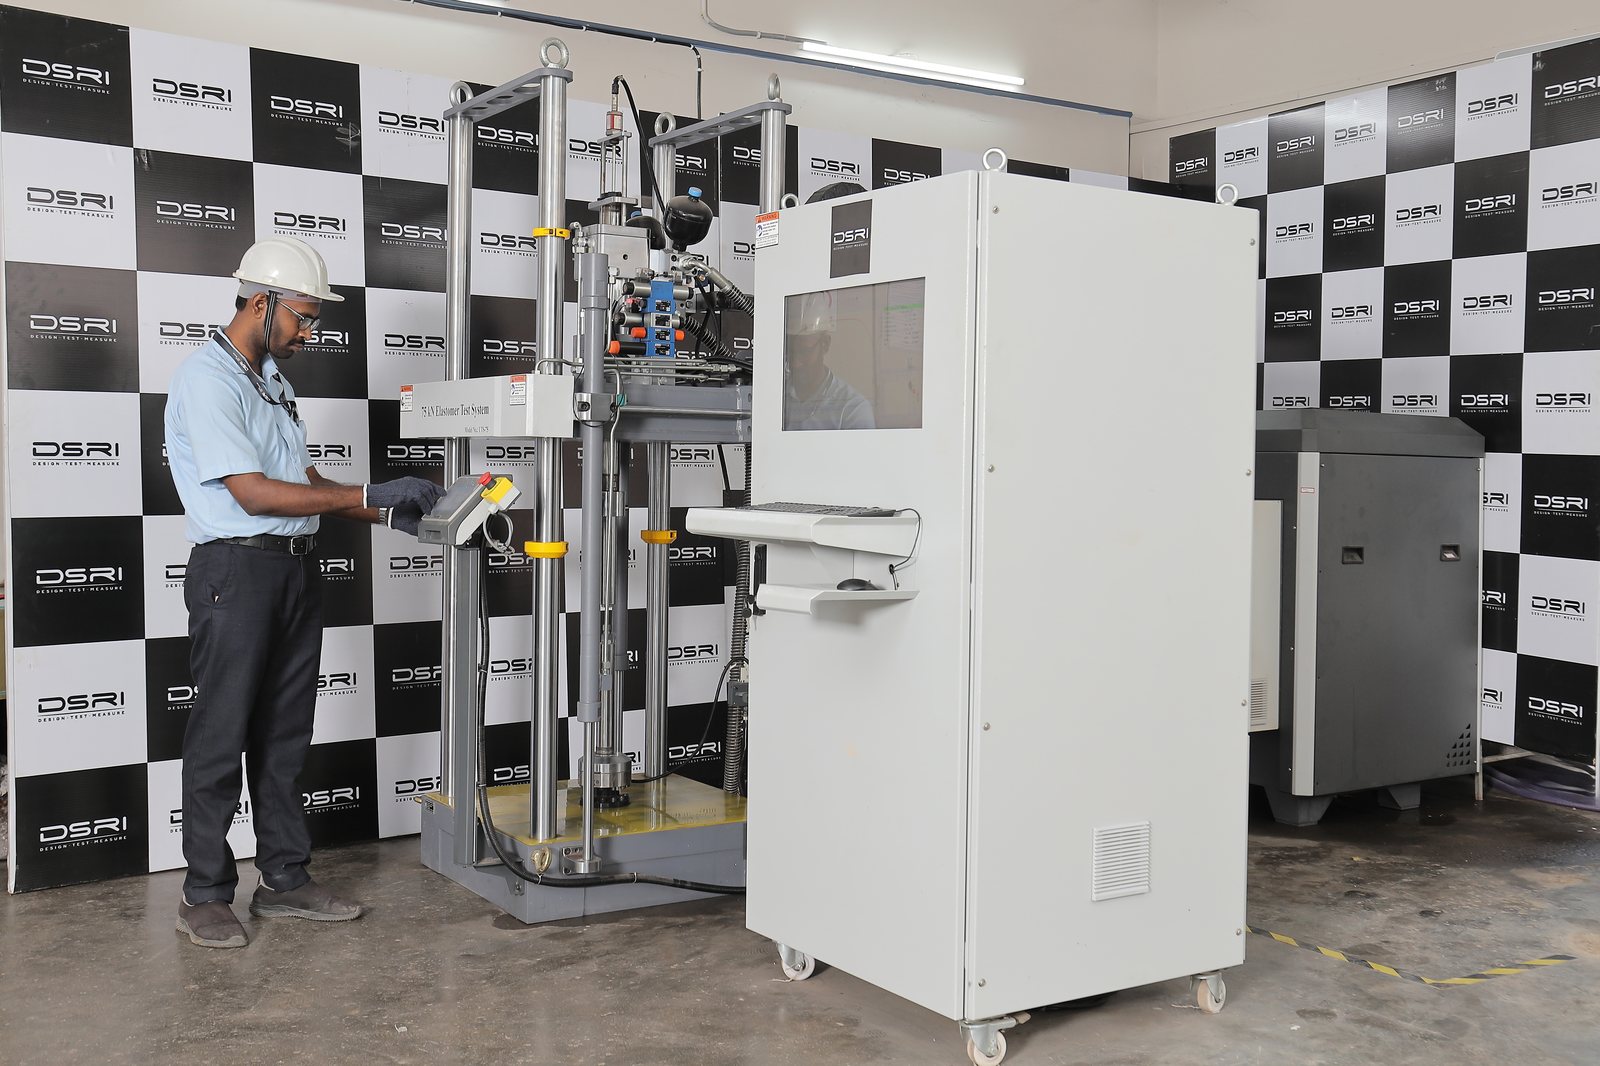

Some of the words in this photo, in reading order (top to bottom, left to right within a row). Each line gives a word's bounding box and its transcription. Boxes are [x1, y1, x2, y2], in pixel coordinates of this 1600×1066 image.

[23, 58, 109, 86] DSRI
[153, 78, 231, 103] DSRI
[271, 95, 343, 119] DSRI
[1468, 92, 1517, 114] DSRI
[379, 111, 445, 133] DSRI
[1399, 108, 1443, 128] DSRI
[1335, 122, 1376, 141] DSRI
[570, 139, 620, 158] DSR
[1278, 134, 1315, 152] DSRI
[734, 146, 760, 160] DS
[1224, 146, 1259, 163] DSRI
[675, 154, 706, 170] SRI
[811, 158, 860, 174] DSRI
[1176, 157, 1207, 173] DSRI
[27, 186, 113, 209] DSRI
[1542, 182, 1596, 201] DSRI
[156, 199, 234, 221] DSRI
[1466, 193, 1515, 212] DSRI
[1334, 213, 1374, 229] DSRI
[1397, 204, 1441, 221] DSRI
[274, 211, 345, 232] DSRI
[1276, 222, 1313, 237] DSRI
[481, 232, 536, 250] DSR
[834, 228, 868, 243] DSRI
[1464, 294, 1512, 309] DSRI
[1540, 287, 1593, 304] DSRI
[1332, 304, 1372, 318] DSRI
[1395, 299, 1439, 314] DSRI
[30, 314, 116, 333] DSRI
[1274, 309, 1311, 322] DSRI
[304, 329, 348, 345] SRI
[384, 334, 444, 350] DSR
[483, 339, 536, 355] DSR
[1273, 396, 1310, 406] DSRI
[1330, 395, 1370, 406] DSRI
[1393, 394, 1437, 406] DSRI
[1461, 394, 1510, 406] DSRI
[1537, 393, 1591, 405] DSRI
[461, 404, 471, 416] Test
[471, 404, 489, 418] System
[33, 442, 118, 457] DSRI
[306, 445, 351, 458] SRI
[387, 446, 444, 459] DSR
[1534, 495, 1588, 510] DSRI
[36, 567, 121, 585] DSRI
[1532, 595, 1585, 614] DSRI
[668, 643, 718, 659] DSRI
[38, 691, 124, 713] DSRI
[1529, 696, 1582, 718] DSRI
[669, 740, 721, 758] DSRI
[494, 764, 529, 781] DS
[40, 815, 126, 841] DSRI
